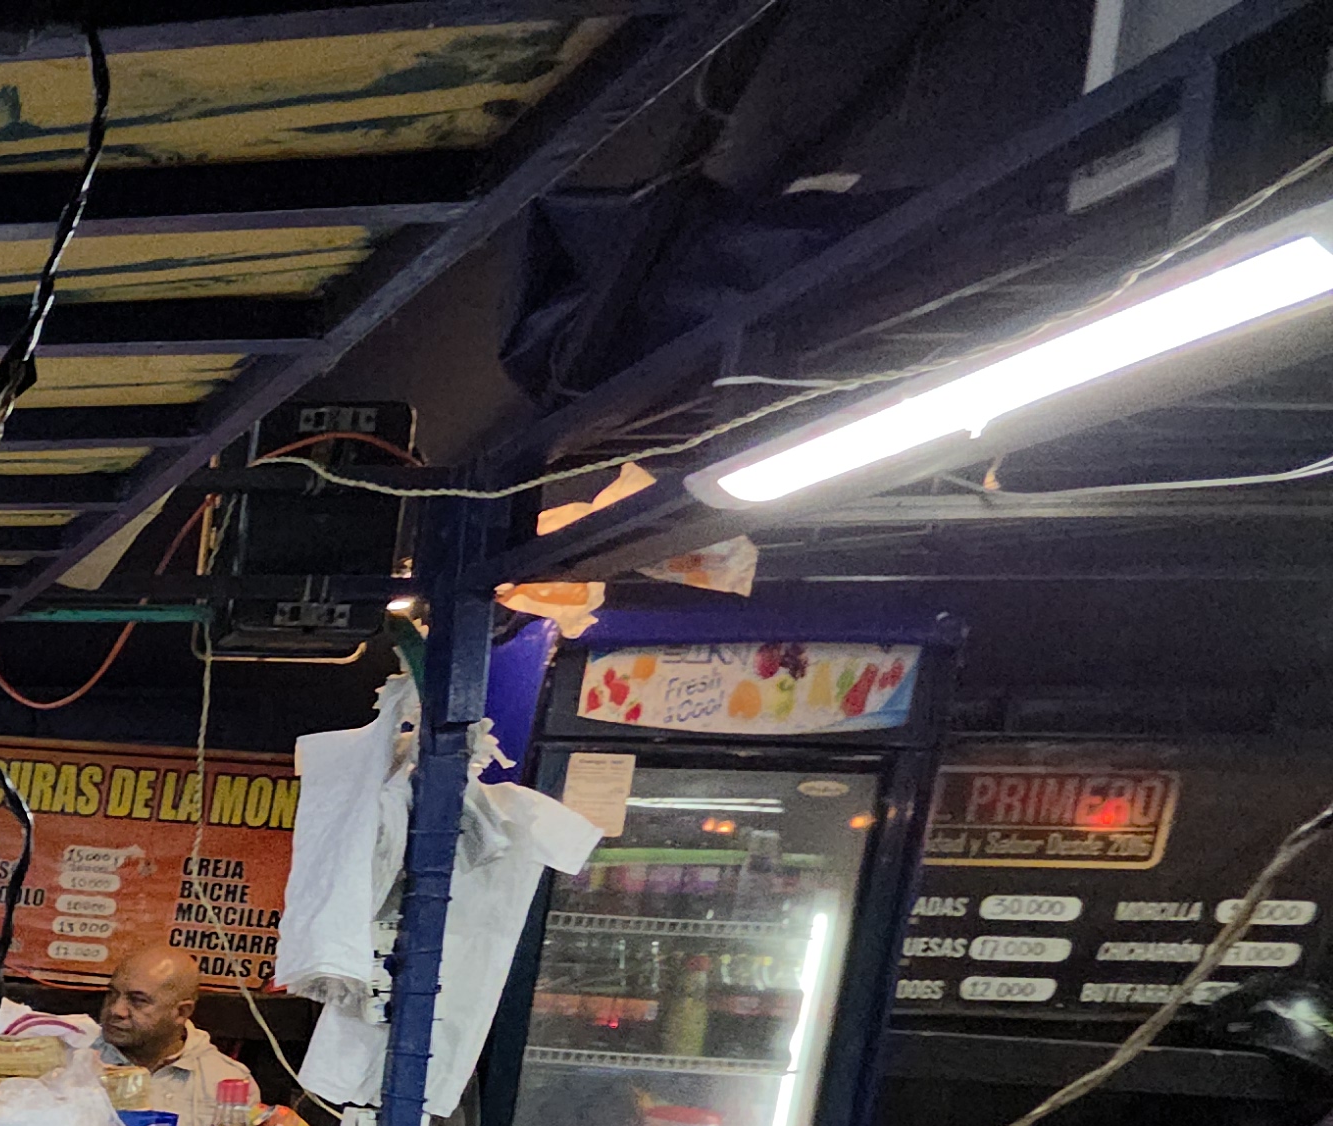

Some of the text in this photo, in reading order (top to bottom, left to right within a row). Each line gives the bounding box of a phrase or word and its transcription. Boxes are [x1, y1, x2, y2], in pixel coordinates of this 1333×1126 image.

[106, 767, 157, 819] DE
[158, 771, 202, 825] LA
[965, 775, 1165, 826] PRIMERO
[180, 881, 250, 903] BUCHE
[175, 903, 281, 930] MORCILLA
[190, 955, 252, 978] ADAS
